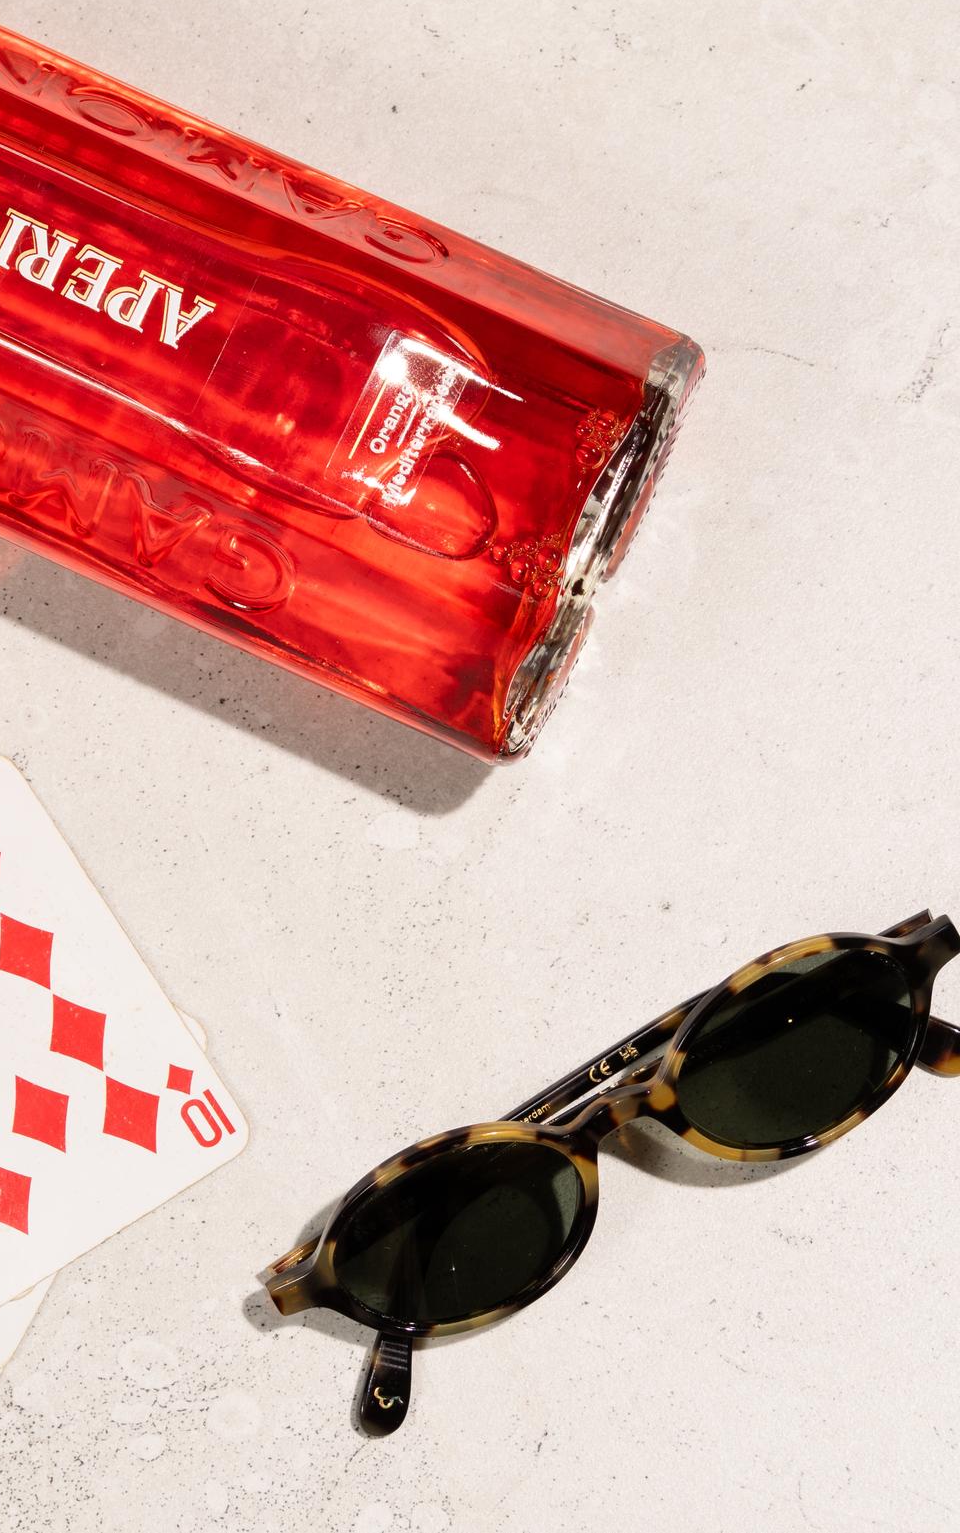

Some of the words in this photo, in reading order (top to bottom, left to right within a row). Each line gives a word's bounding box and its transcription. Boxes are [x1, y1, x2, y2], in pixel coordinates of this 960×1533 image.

[588, 1059, 613, 1083] CE
[179, 1089, 237, 1150] 10
[520, 1102, 551, 1124] erdam
